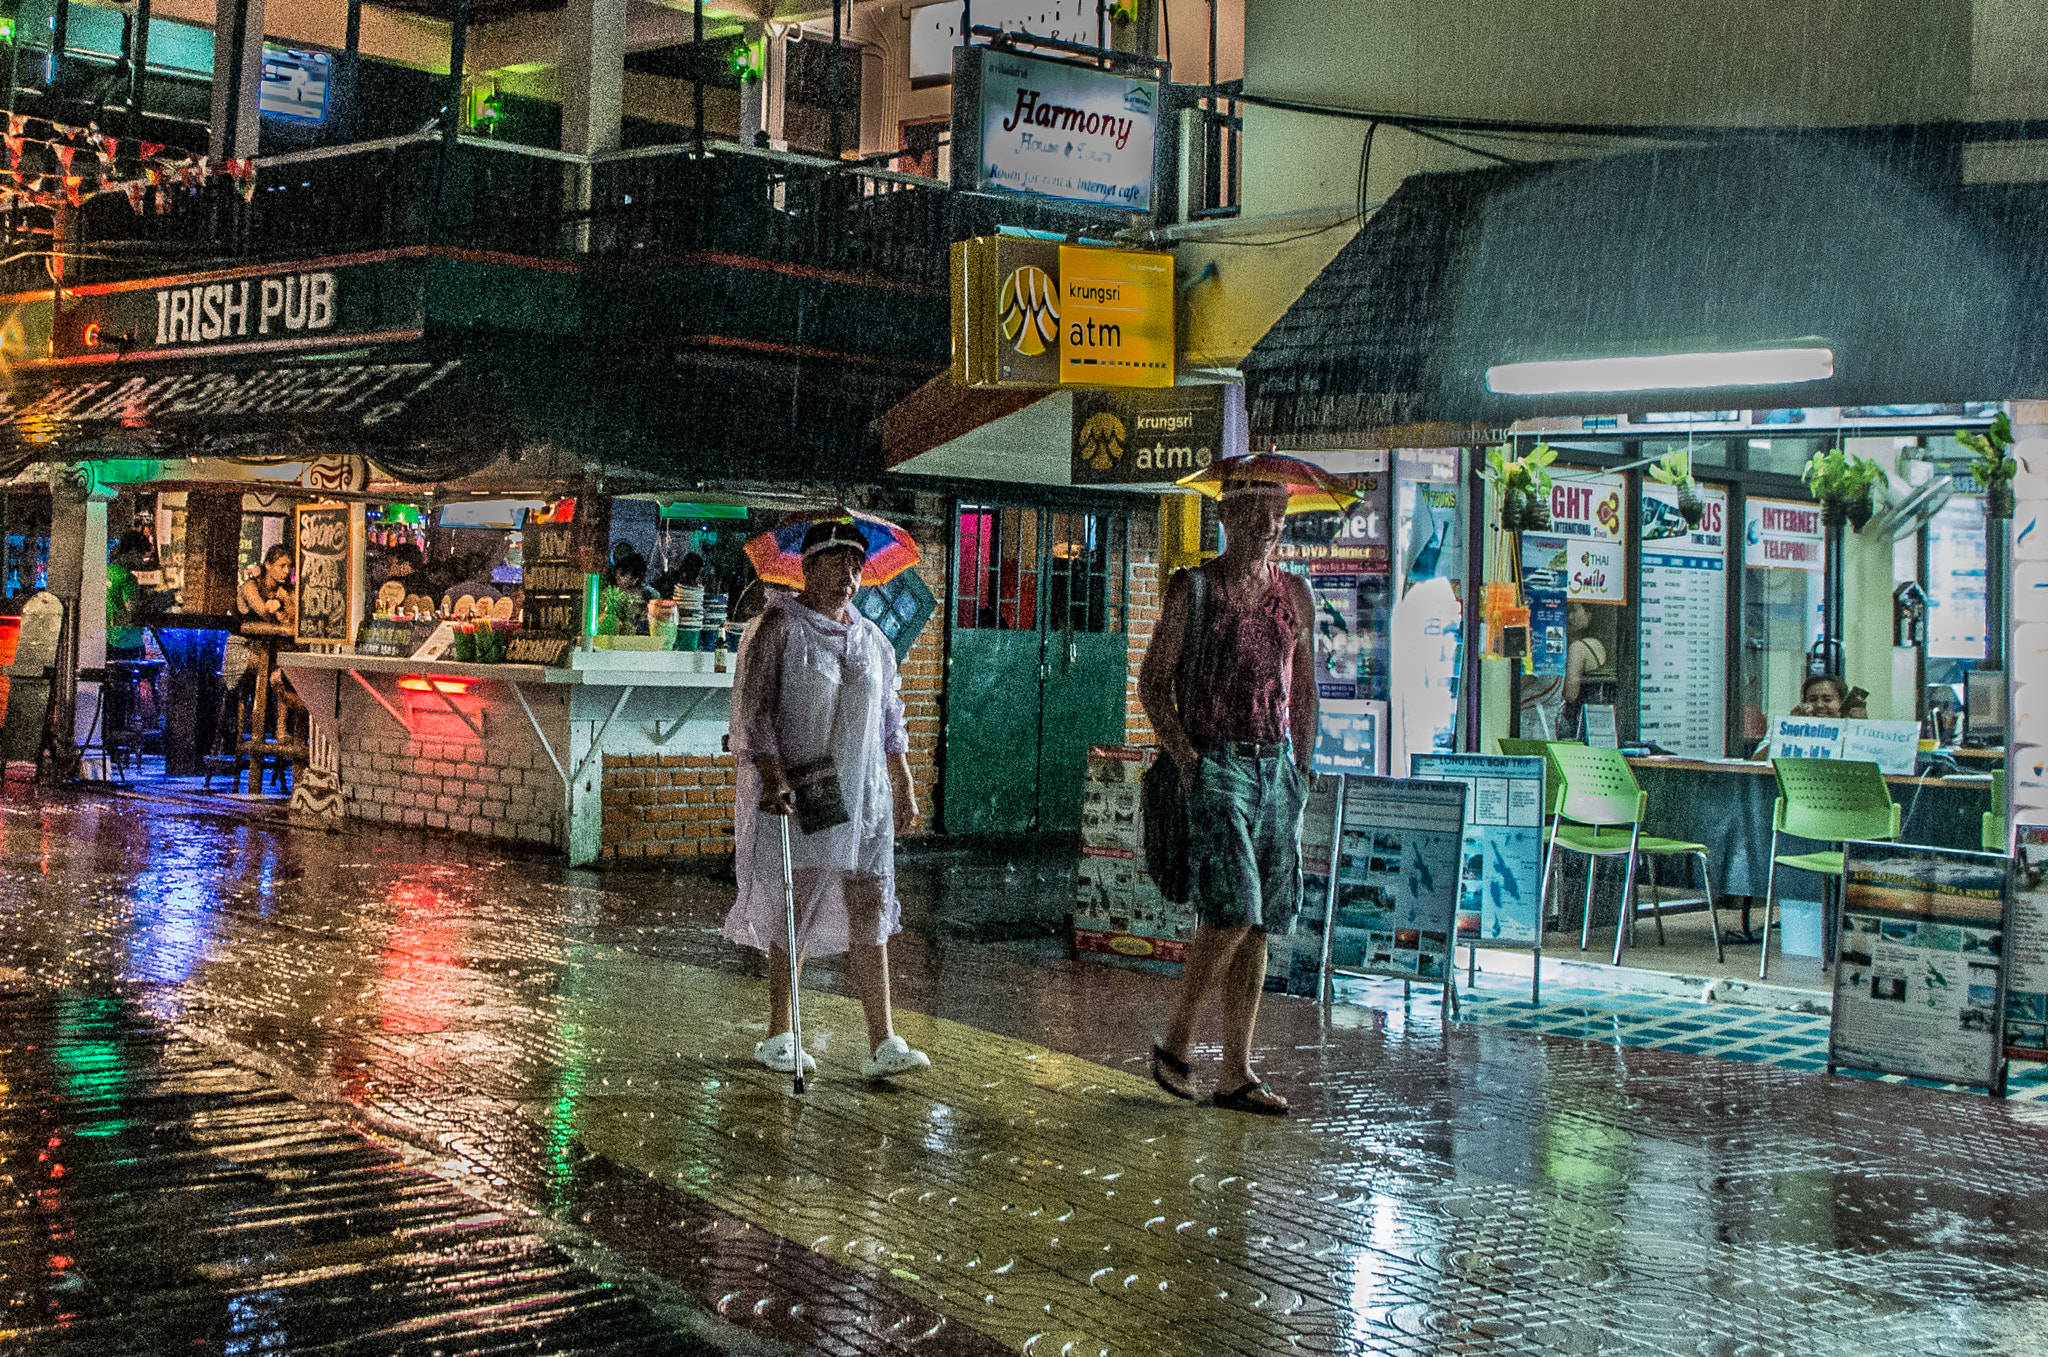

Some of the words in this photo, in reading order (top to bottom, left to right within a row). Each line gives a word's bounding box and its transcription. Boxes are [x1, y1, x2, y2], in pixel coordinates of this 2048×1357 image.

[1003, 89, 1133, 150] Harmony
[1077, 177, 1117, 196] Internet
[1118, 184, 1141, 203] cafe
[1069, 283, 1121, 303] krungsri
[156, 280, 249, 345] IRISH
[258, 271, 336, 334] PUB
[1070, 316, 1121, 348] atm
[1137, 412, 1193, 430] krungsri
[1136, 442, 1188, 470] atm
[1701, 502, 1722, 533] US
[1762, 506, 1819, 534] INTERNET
[1706, 534, 1722, 547] TABLE
[1763, 540, 1818, 561] TELEPHONE
[1590, 553, 1610, 567] THAI
[1569, 569, 1609, 594] Smile
[1780, 721, 1839, 741] Snorkeling
[1854, 724, 1914, 743] Transfer
[1439, 756, 1465, 767] LONG
[1467, 757, 1486, 768] TAIL
[1487, 758, 1510, 769] BOAT
[1511, 759, 1532, 769] TRIP
